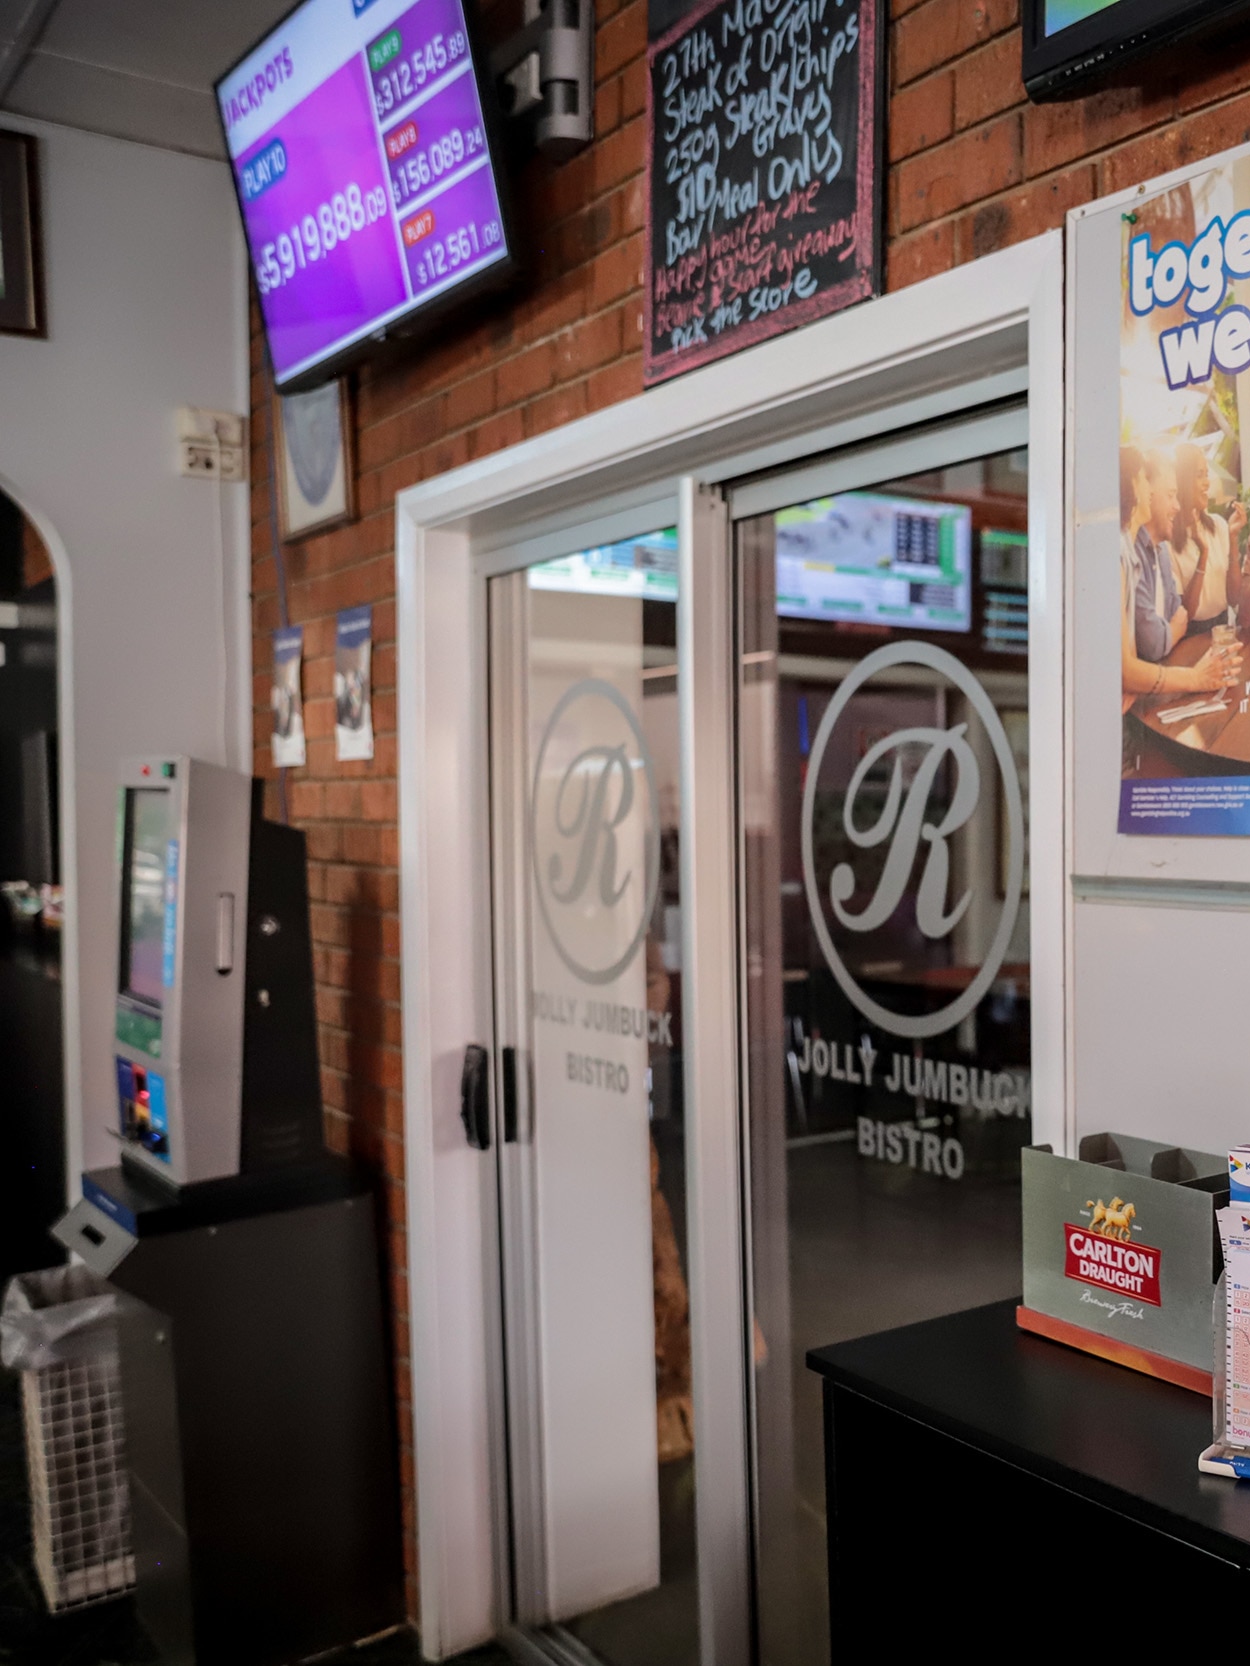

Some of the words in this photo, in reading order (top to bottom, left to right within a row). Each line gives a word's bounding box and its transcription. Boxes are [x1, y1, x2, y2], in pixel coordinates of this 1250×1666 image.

[223, 46, 294, 129] JACKPOTS
[1239, 698, 1249, 714] IT
[566, 1052, 630, 1094] BISTRO
[799, 1036, 878, 1087] JOLLY
[857, 1116, 965, 1180] BISTRO
[1069, 1233, 1154, 1278] CARLTON
[1079, 1259, 1144, 1293] DRAUGHT
